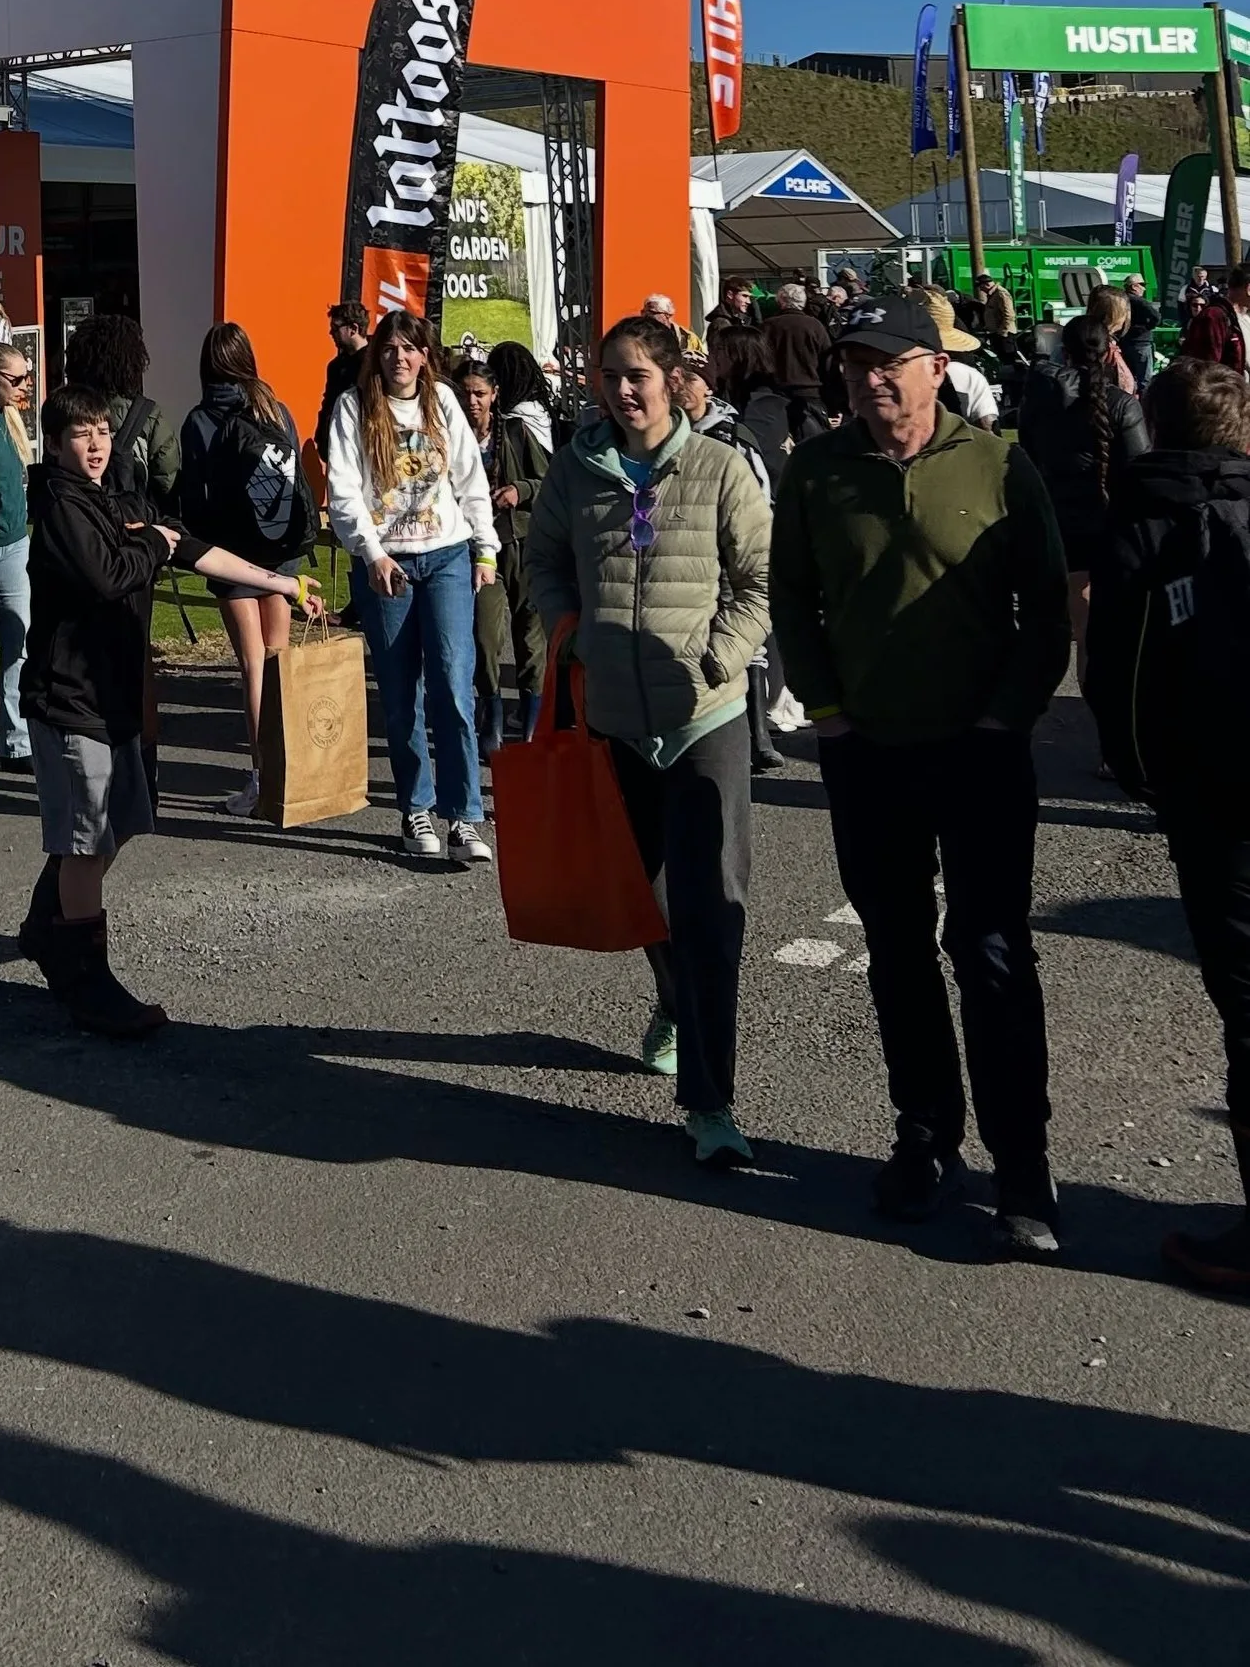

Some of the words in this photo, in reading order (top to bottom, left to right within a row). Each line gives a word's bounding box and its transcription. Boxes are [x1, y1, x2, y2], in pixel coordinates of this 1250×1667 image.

[1066, 26, 1198, 54] HUSTLER
[785, 177, 831, 194] POLARIS
[1013, 140, 1024, 226] HUSTLER
[450, 235, 510, 261] GARDEN
[1044, 257, 1089, 265] HUSTLER
[1097, 257, 1132, 265] COMBI
[1165, 201, 1195, 308] HUSTLER
